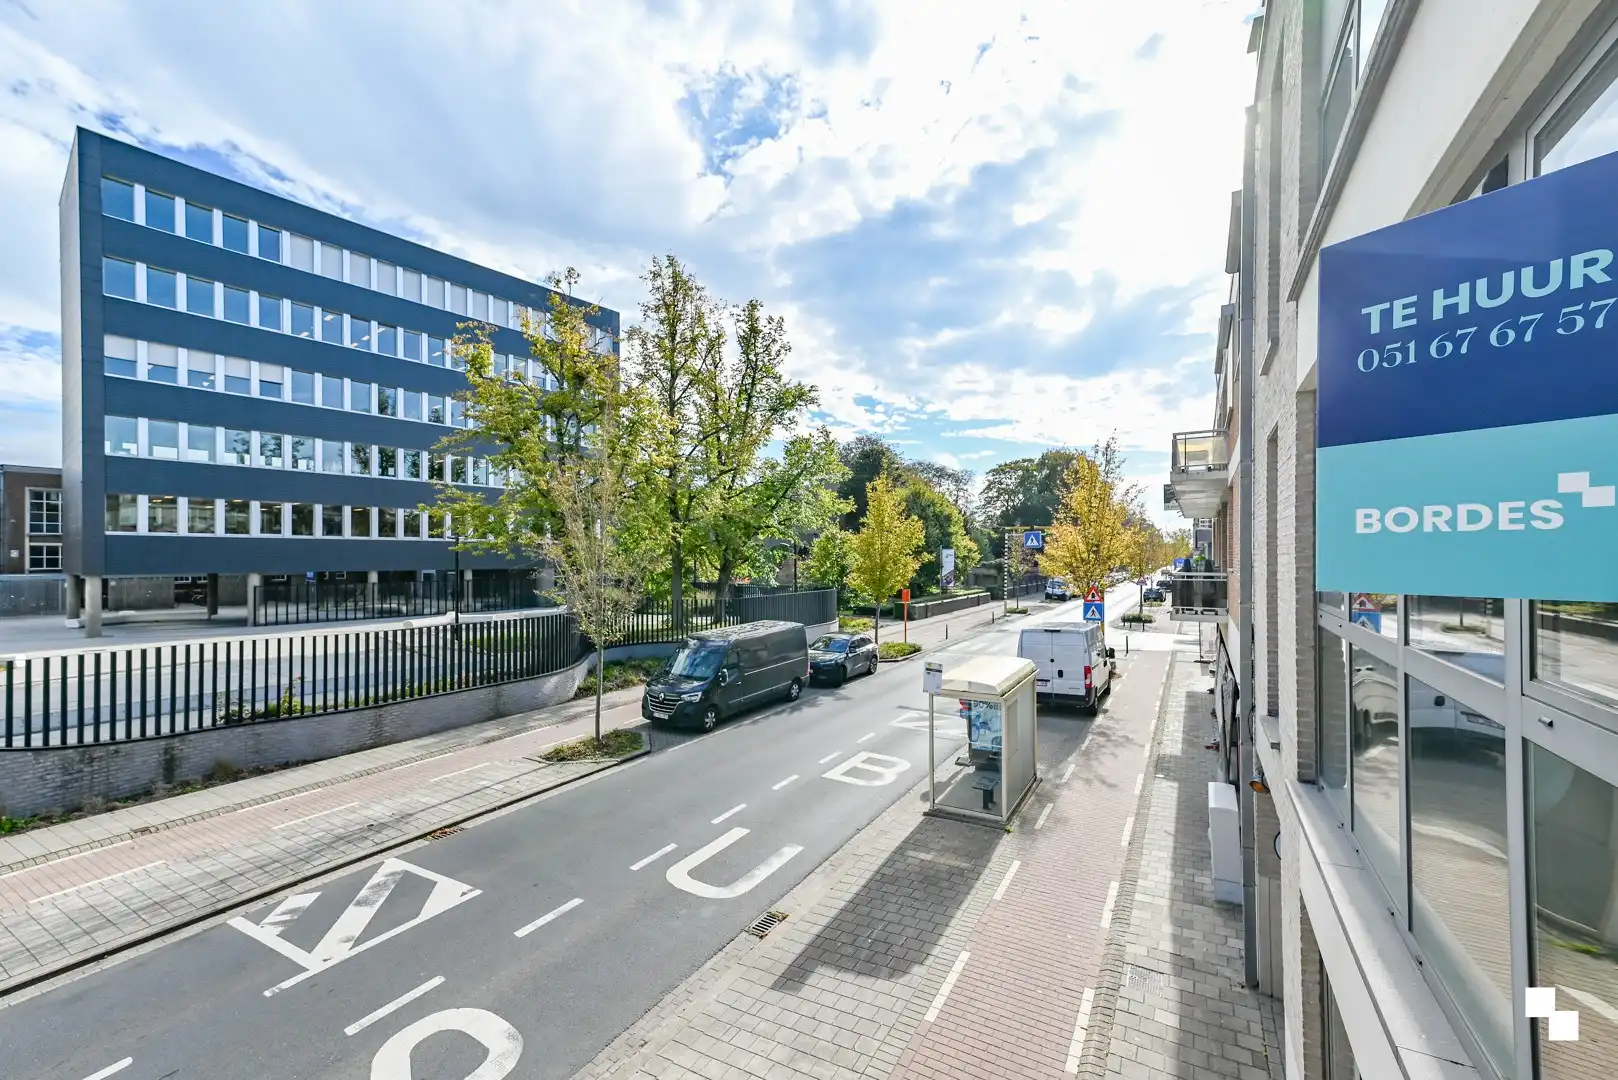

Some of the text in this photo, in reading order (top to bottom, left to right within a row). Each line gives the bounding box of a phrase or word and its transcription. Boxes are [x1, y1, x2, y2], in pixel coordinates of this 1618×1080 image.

[1361, 249, 1614, 335] TE HUUR
[1357, 297, 1618, 373] 051 67 67 57
[1356, 500, 1564, 534] BORDES
